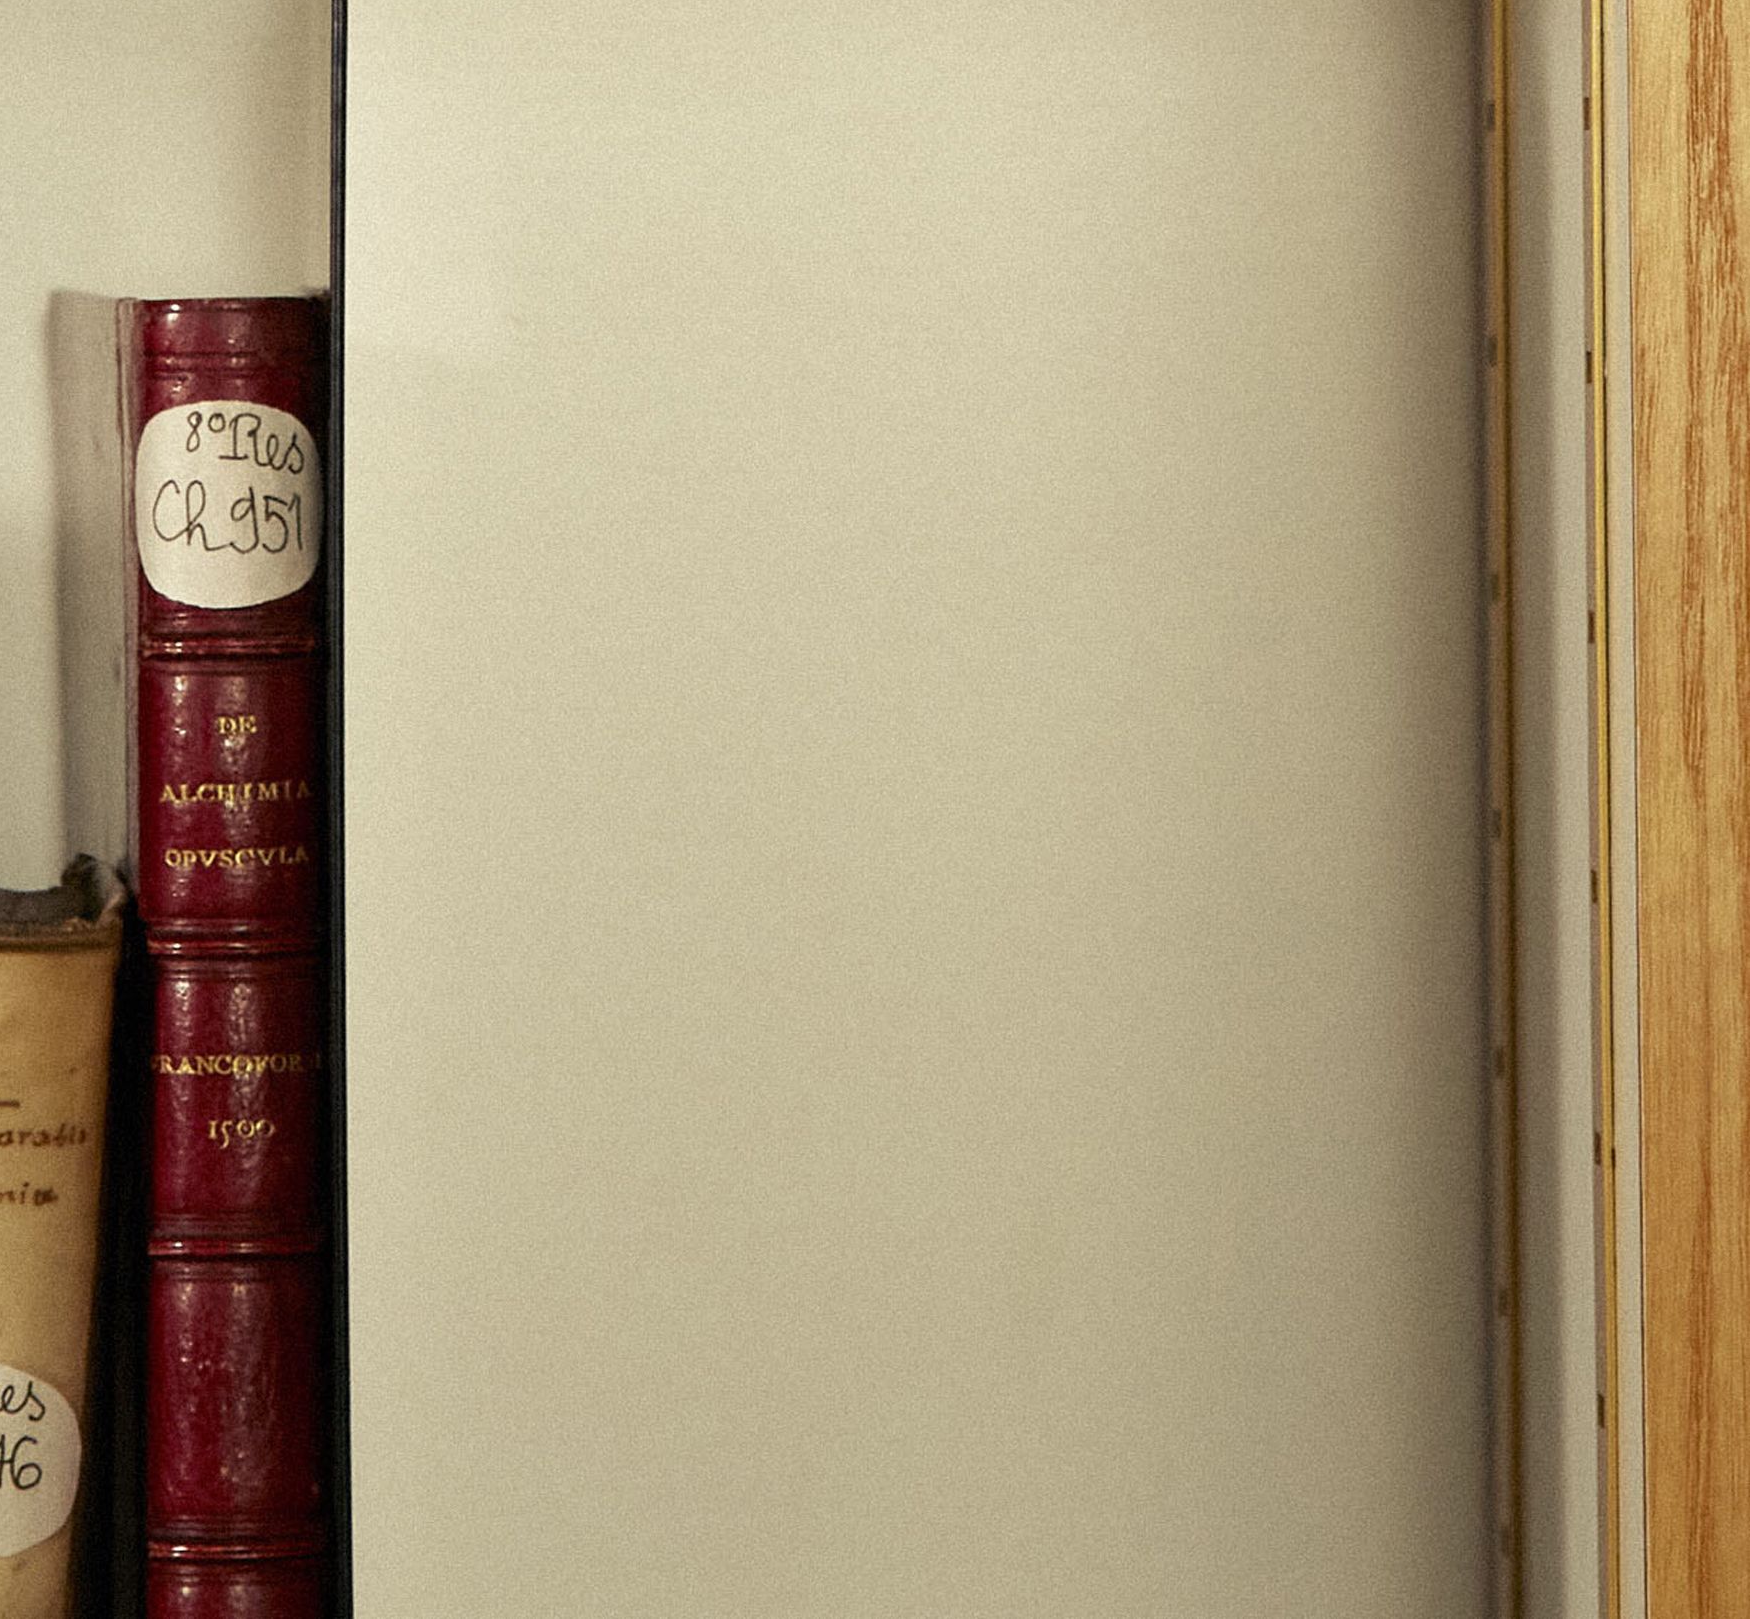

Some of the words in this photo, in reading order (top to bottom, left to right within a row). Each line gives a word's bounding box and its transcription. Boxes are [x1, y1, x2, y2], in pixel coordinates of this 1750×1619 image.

[217, 714, 258, 735] DE
[159, 779, 312, 805] ALCHIMIA
[164, 845, 310, 868] OPVSCVLA
